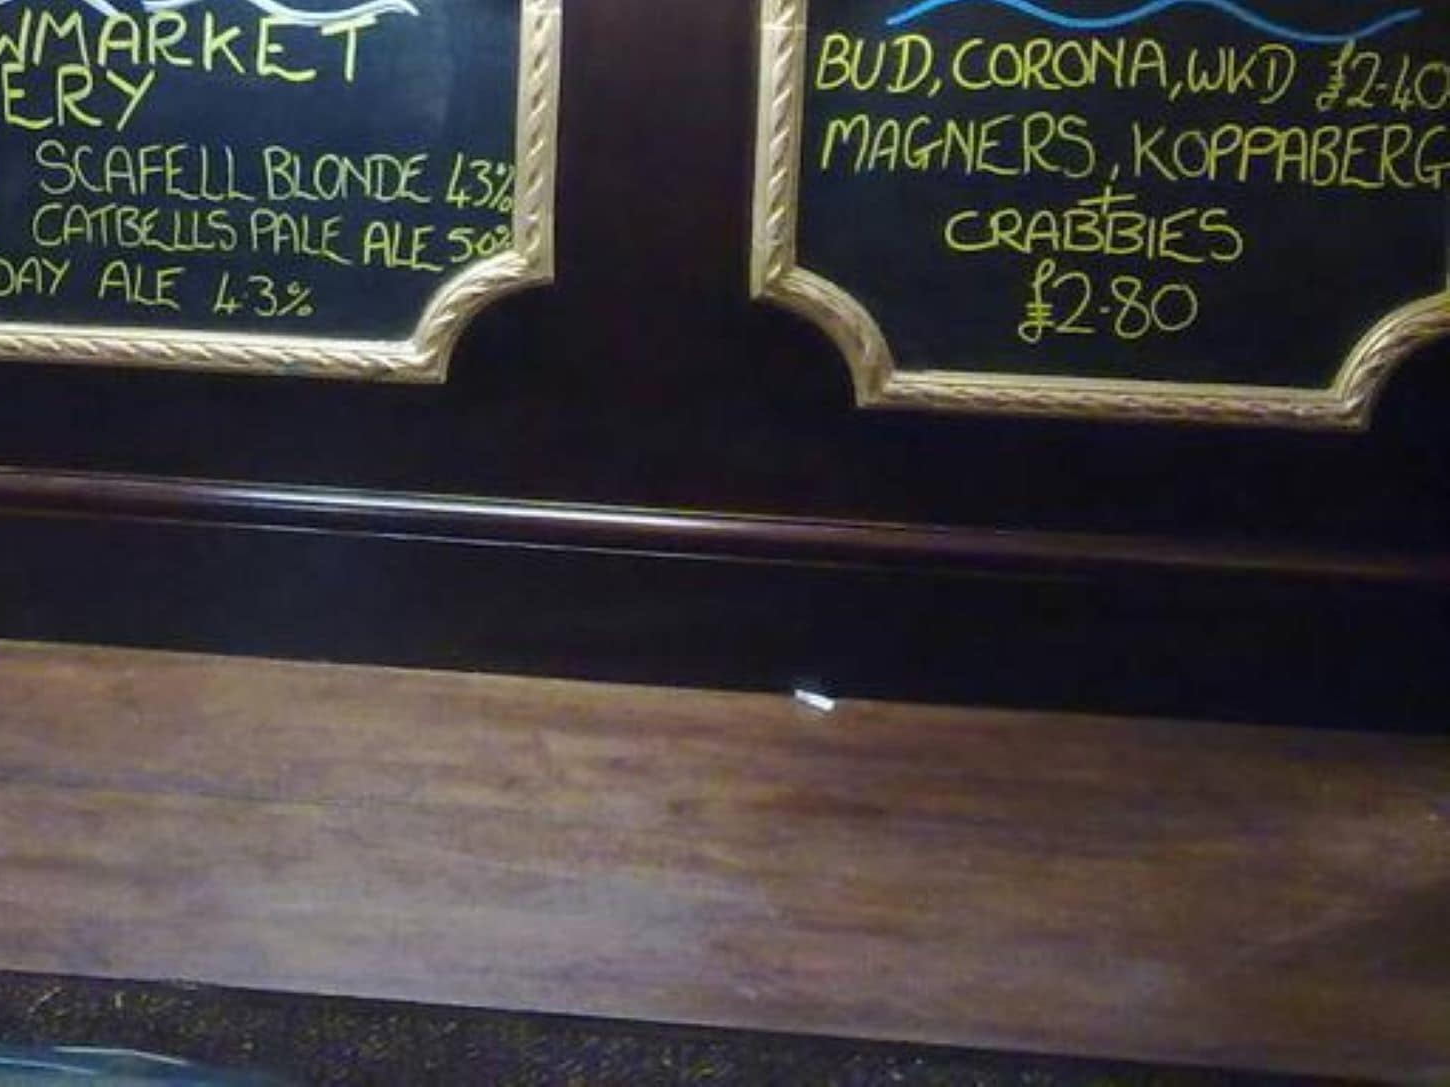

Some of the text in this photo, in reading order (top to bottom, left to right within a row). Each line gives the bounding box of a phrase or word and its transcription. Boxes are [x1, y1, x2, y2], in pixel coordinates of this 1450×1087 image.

[34, 139, 256, 201] SCAFELL
[262, 144, 431, 204] BLONDE
[1132, 122, 1450, 191] KOPPABERG
[32, 201, 239, 252] CATBELLS
[250, 207, 354, 265] PALE
[363, 220, 444, 271] ALE
[944, 207, 1244, 263] CRABBIES
[98, 261, 187, 311] ALE
